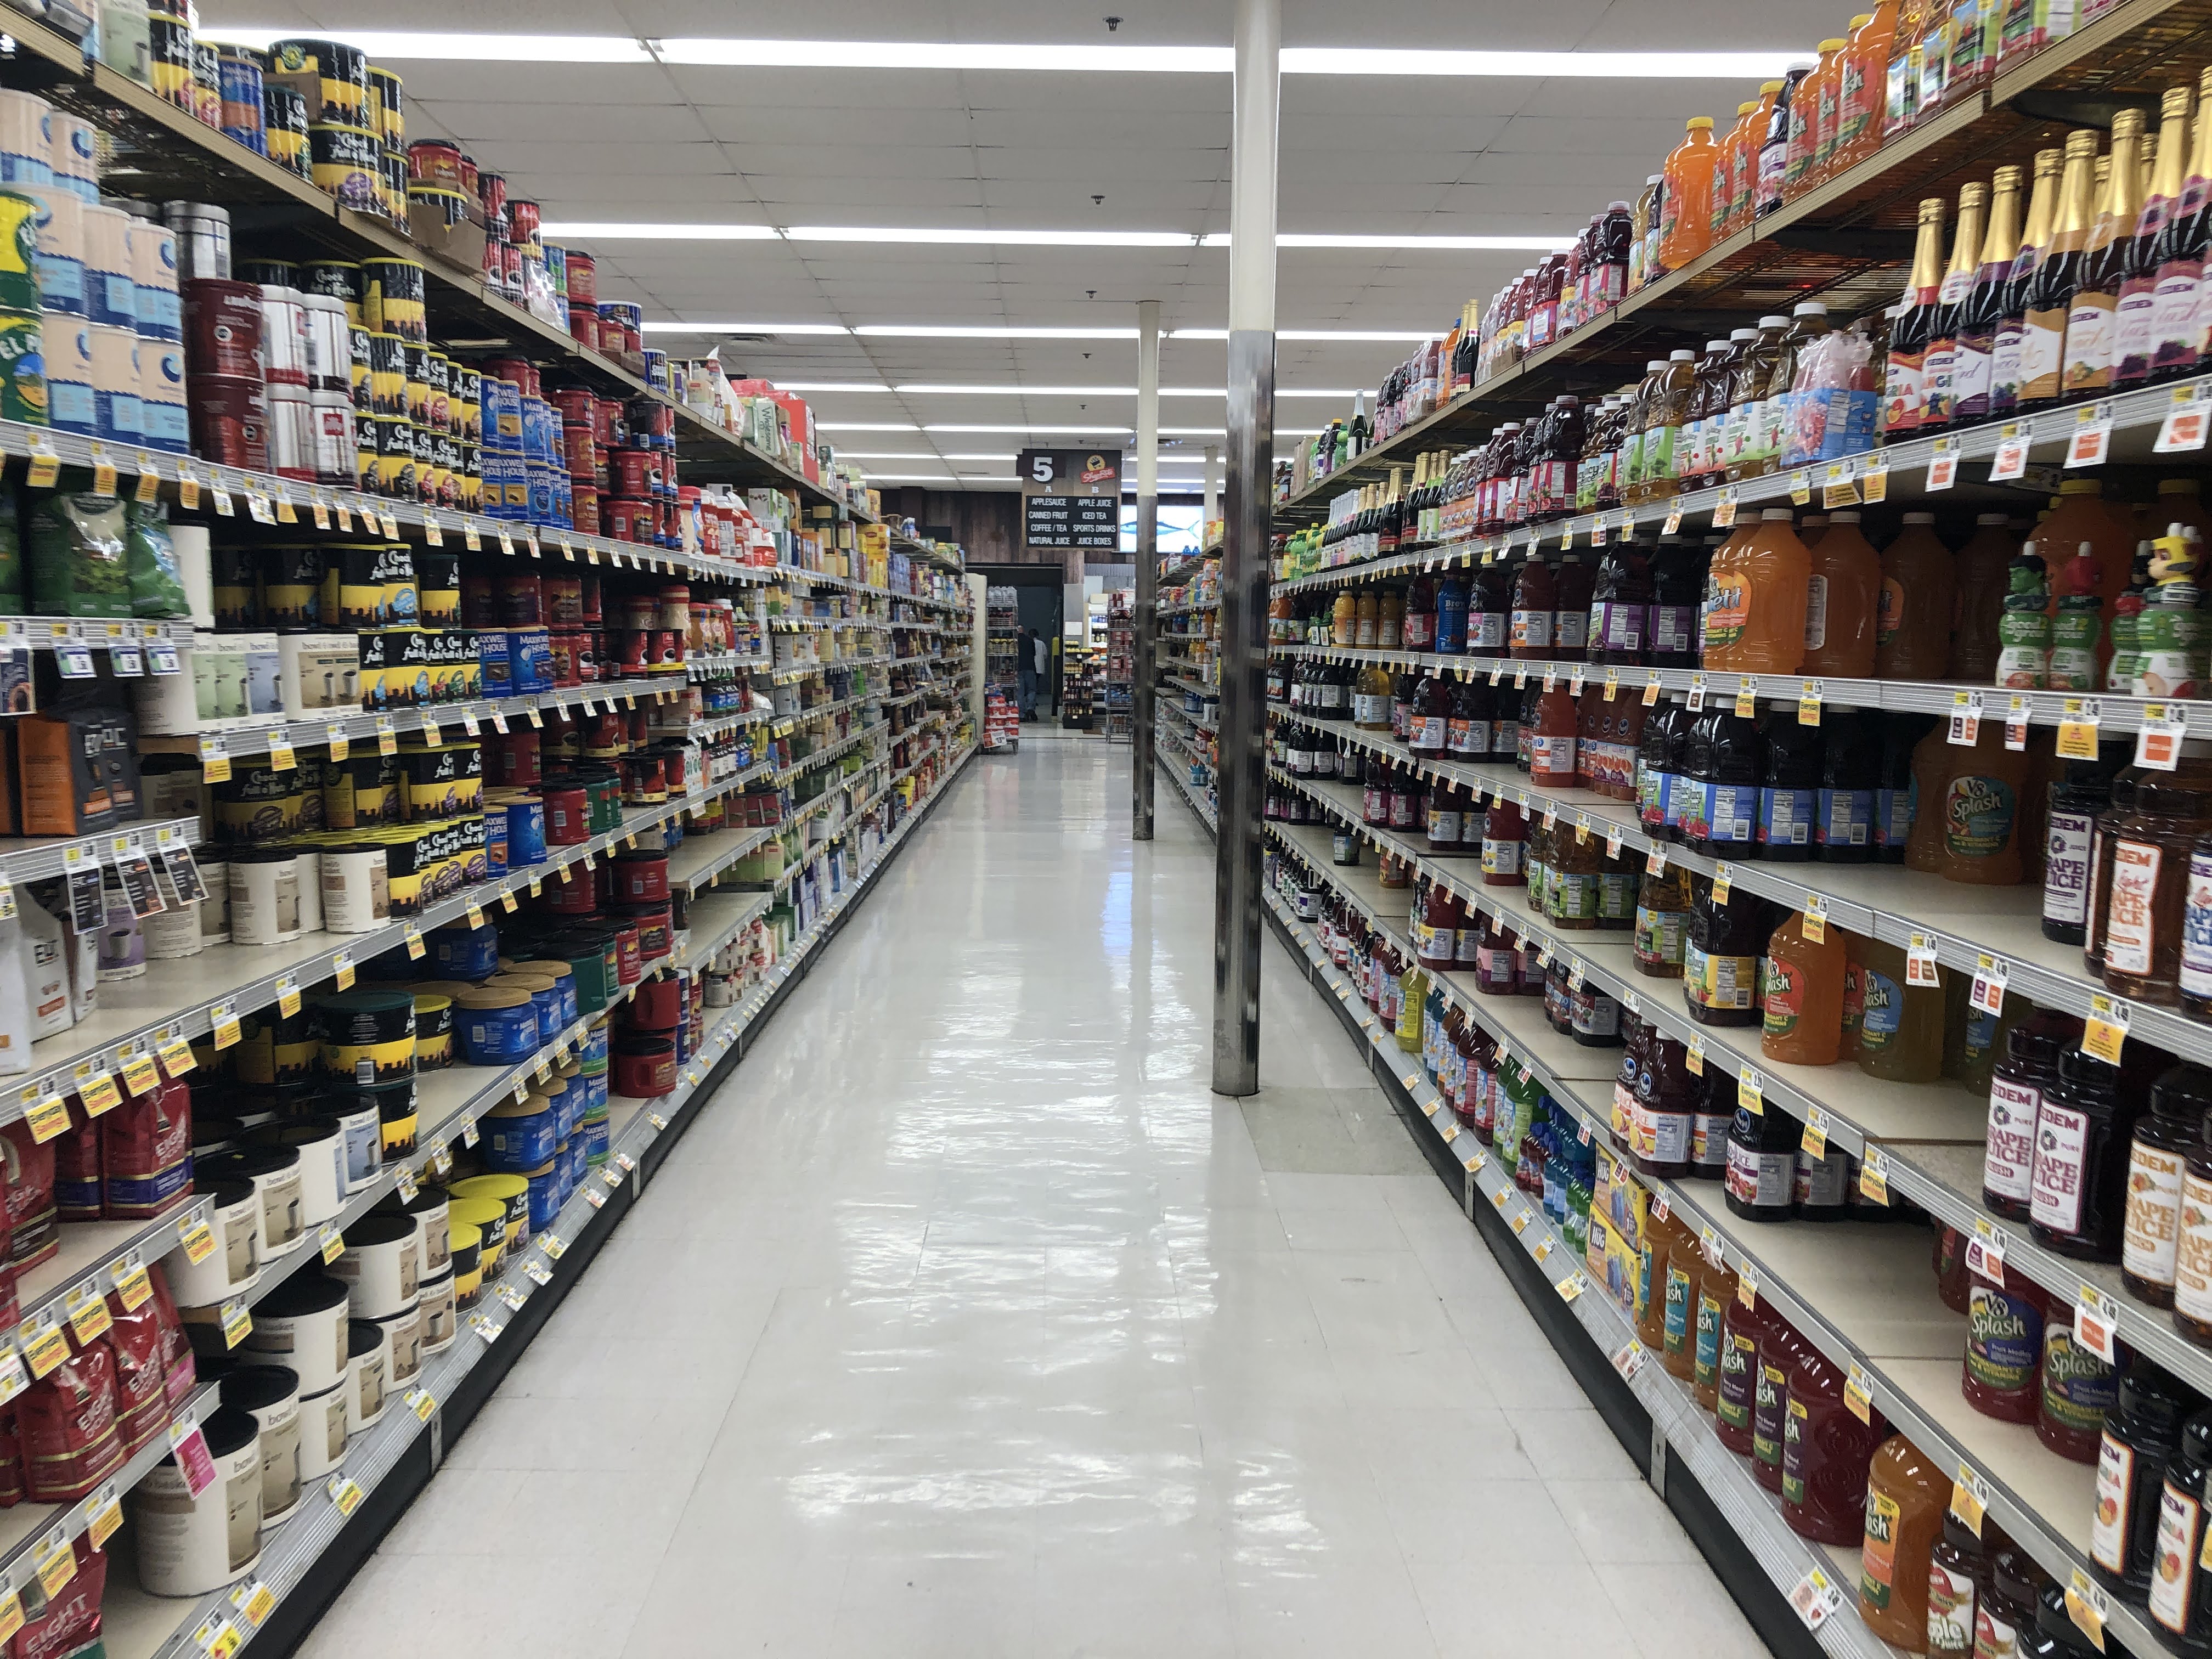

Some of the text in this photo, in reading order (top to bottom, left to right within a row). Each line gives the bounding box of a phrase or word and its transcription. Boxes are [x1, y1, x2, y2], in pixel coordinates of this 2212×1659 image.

[761, 407, 772, 451] Wholesome
[1032, 456, 1053, 482] 5
[1031, 524, 1053, 532] COFFEE
[1953, 792, 2002, 822] Splash
[1741, 1086, 1758, 1103] Everyday
[1992, 1083, 2032, 1106] EDEM
[1804, 1126, 1824, 1147] Everyday
[1862, 1170, 1884, 1193] Everyday
[1984, 1293, 2009, 1317] V8
[1971, 1312, 2025, 1341] Splash
[2049, 1350, 2111, 1381] Splash
[25, 1593, 88, 1653] EIGHT
